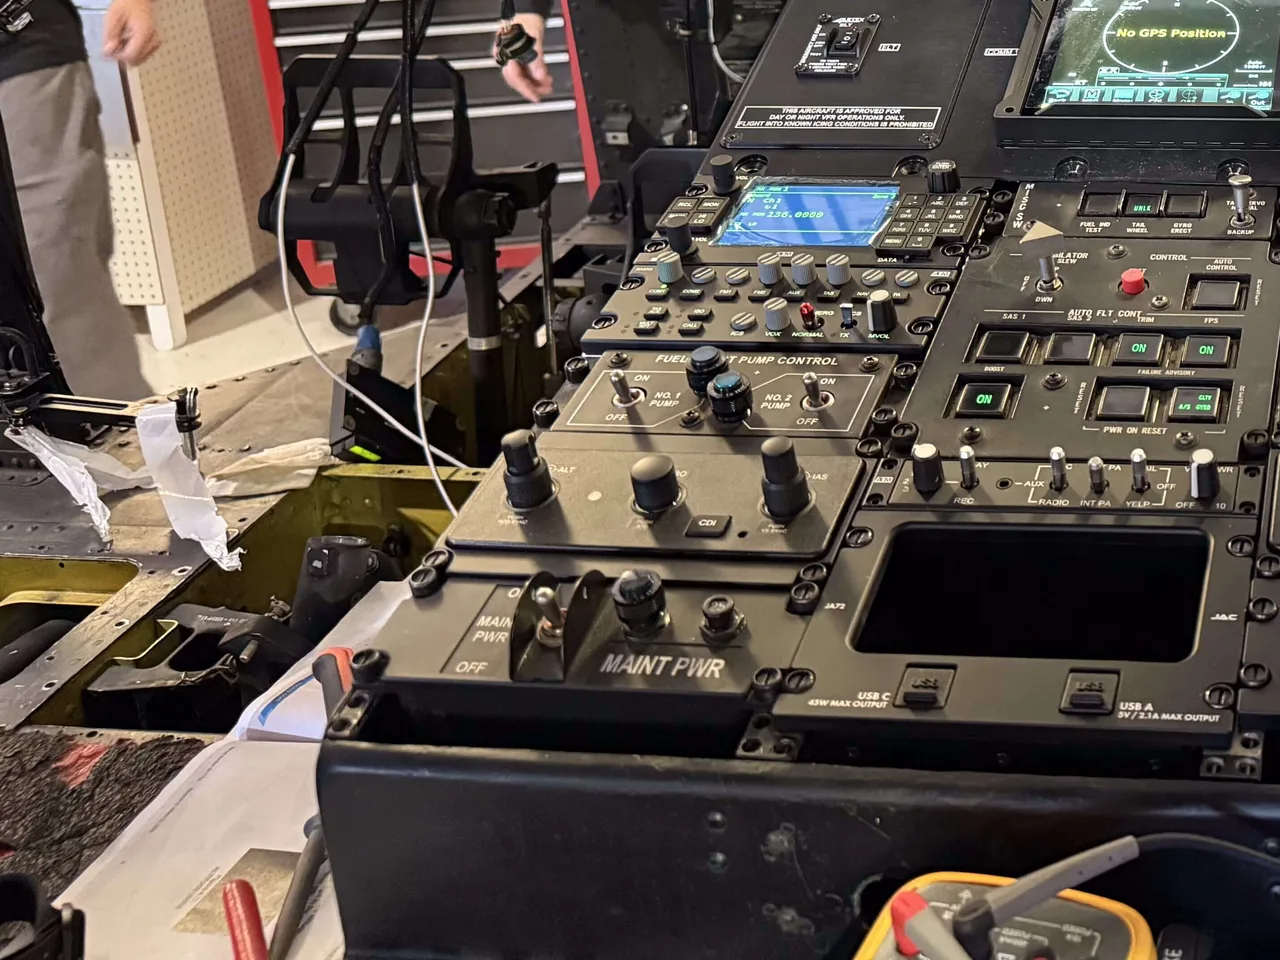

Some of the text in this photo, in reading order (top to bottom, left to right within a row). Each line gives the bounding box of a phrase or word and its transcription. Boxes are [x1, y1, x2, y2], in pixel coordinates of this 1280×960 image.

[1116, 29, 1226, 38] No GPS Position
[1118, 310, 1142, 318] CONT
[1131, 343, 1147, 353] ON
[1199, 345, 1214, 355] ON
[655, 355, 688, 363] FUEL
[740, 356, 774, 365] PUMP
[778, 357, 838, 366] CONTROL
[634, 374, 651, 382] ON
[976, 394, 992, 404] ON
[1103, 427, 1168, 436] PWR ON RESET
[698, 518, 717, 527] CDI
[472, 631, 508, 643] PWR
[456, 661, 488, 674] OFF
[599, 653, 726, 678] MAINT PWR
[858, 691, 890, 701] USB C
[808, 697, 889, 709] 45W MAX OUTPUT
